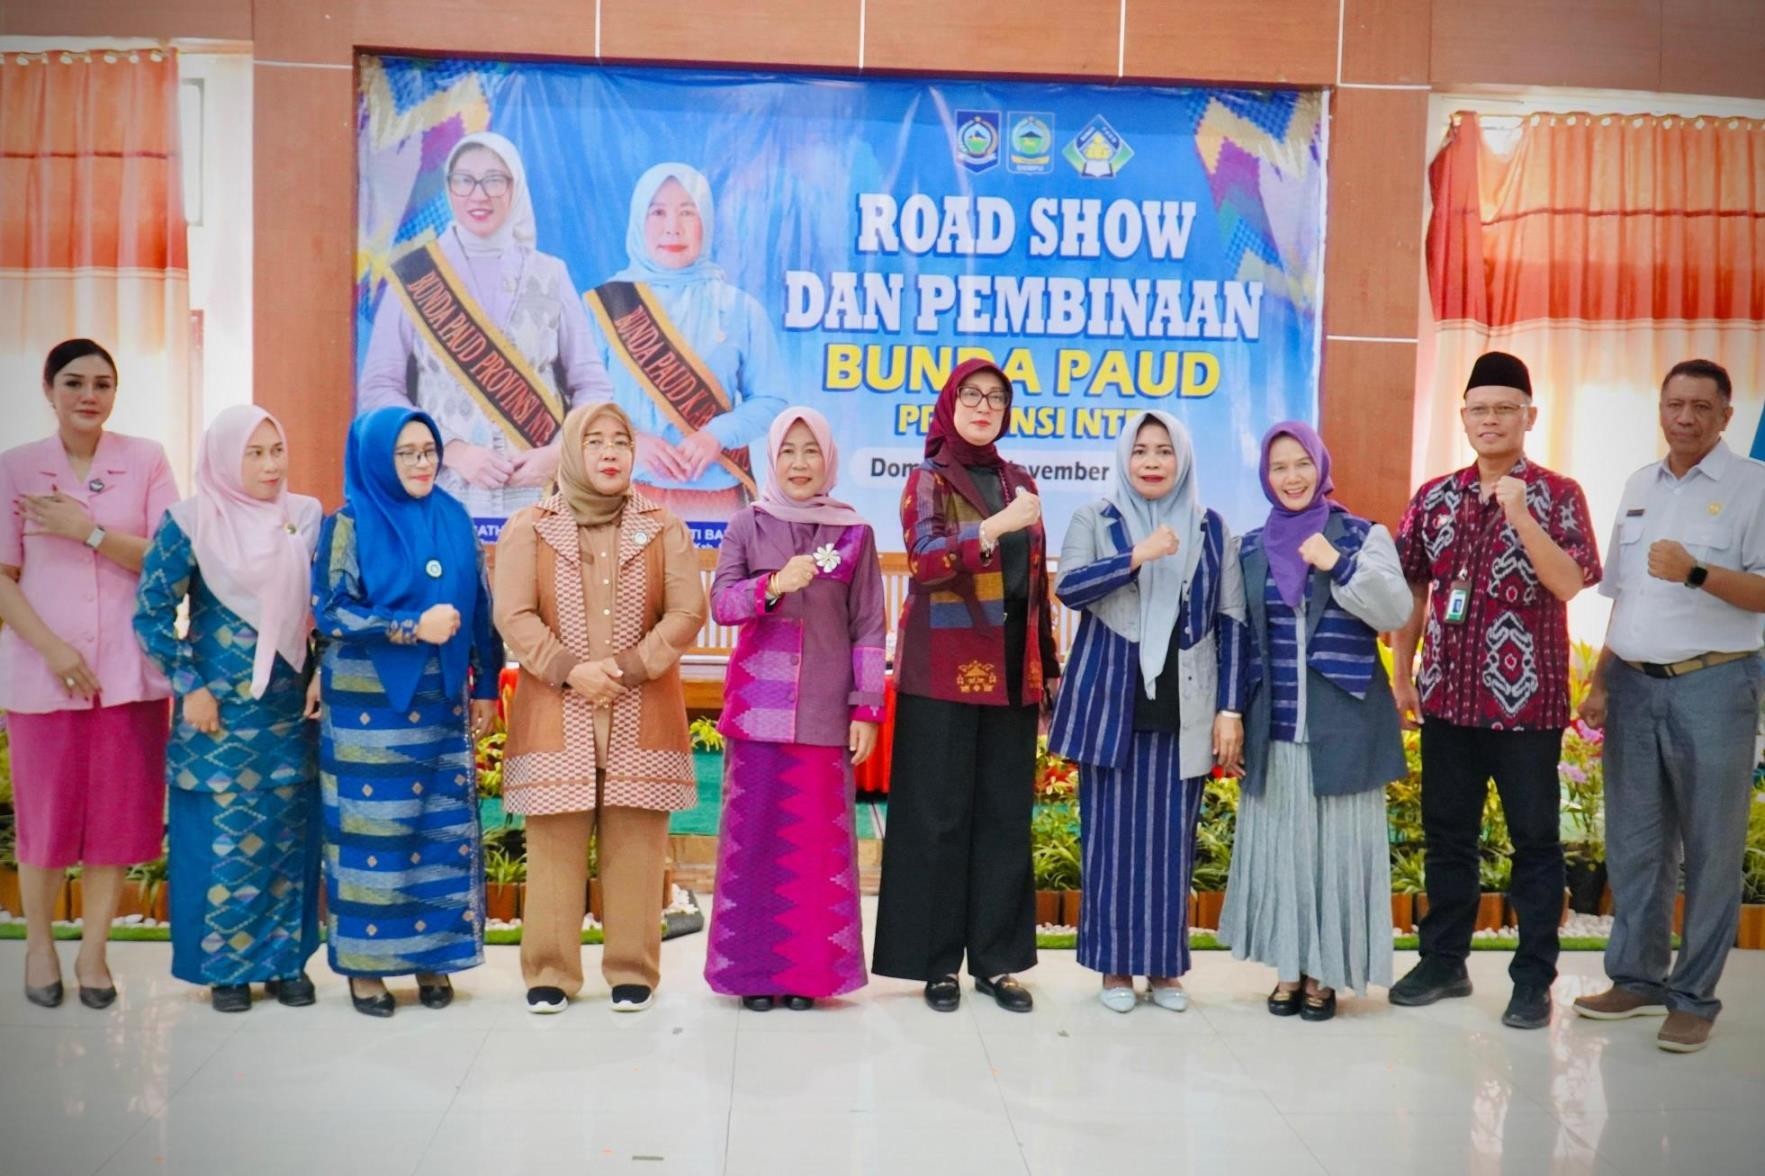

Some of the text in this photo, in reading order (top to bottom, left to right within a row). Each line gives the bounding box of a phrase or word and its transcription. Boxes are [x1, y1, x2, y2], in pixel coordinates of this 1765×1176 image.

[856, 193, 1197, 260] ROAD SHOW
[784, 270, 1264, 340] DAN PEMBINAAN
[407, 270, 458, 330] BUNDA
[438, 311, 487, 362] PAUD
[470, 350, 539, 425] PROVINSI
[614, 304, 664, 365] BUNDA
[649, 351, 697, 401] PAUD
[823, 344, 1221, 397] BUNA PAUD
[1009, 460, 1110, 481] vember
